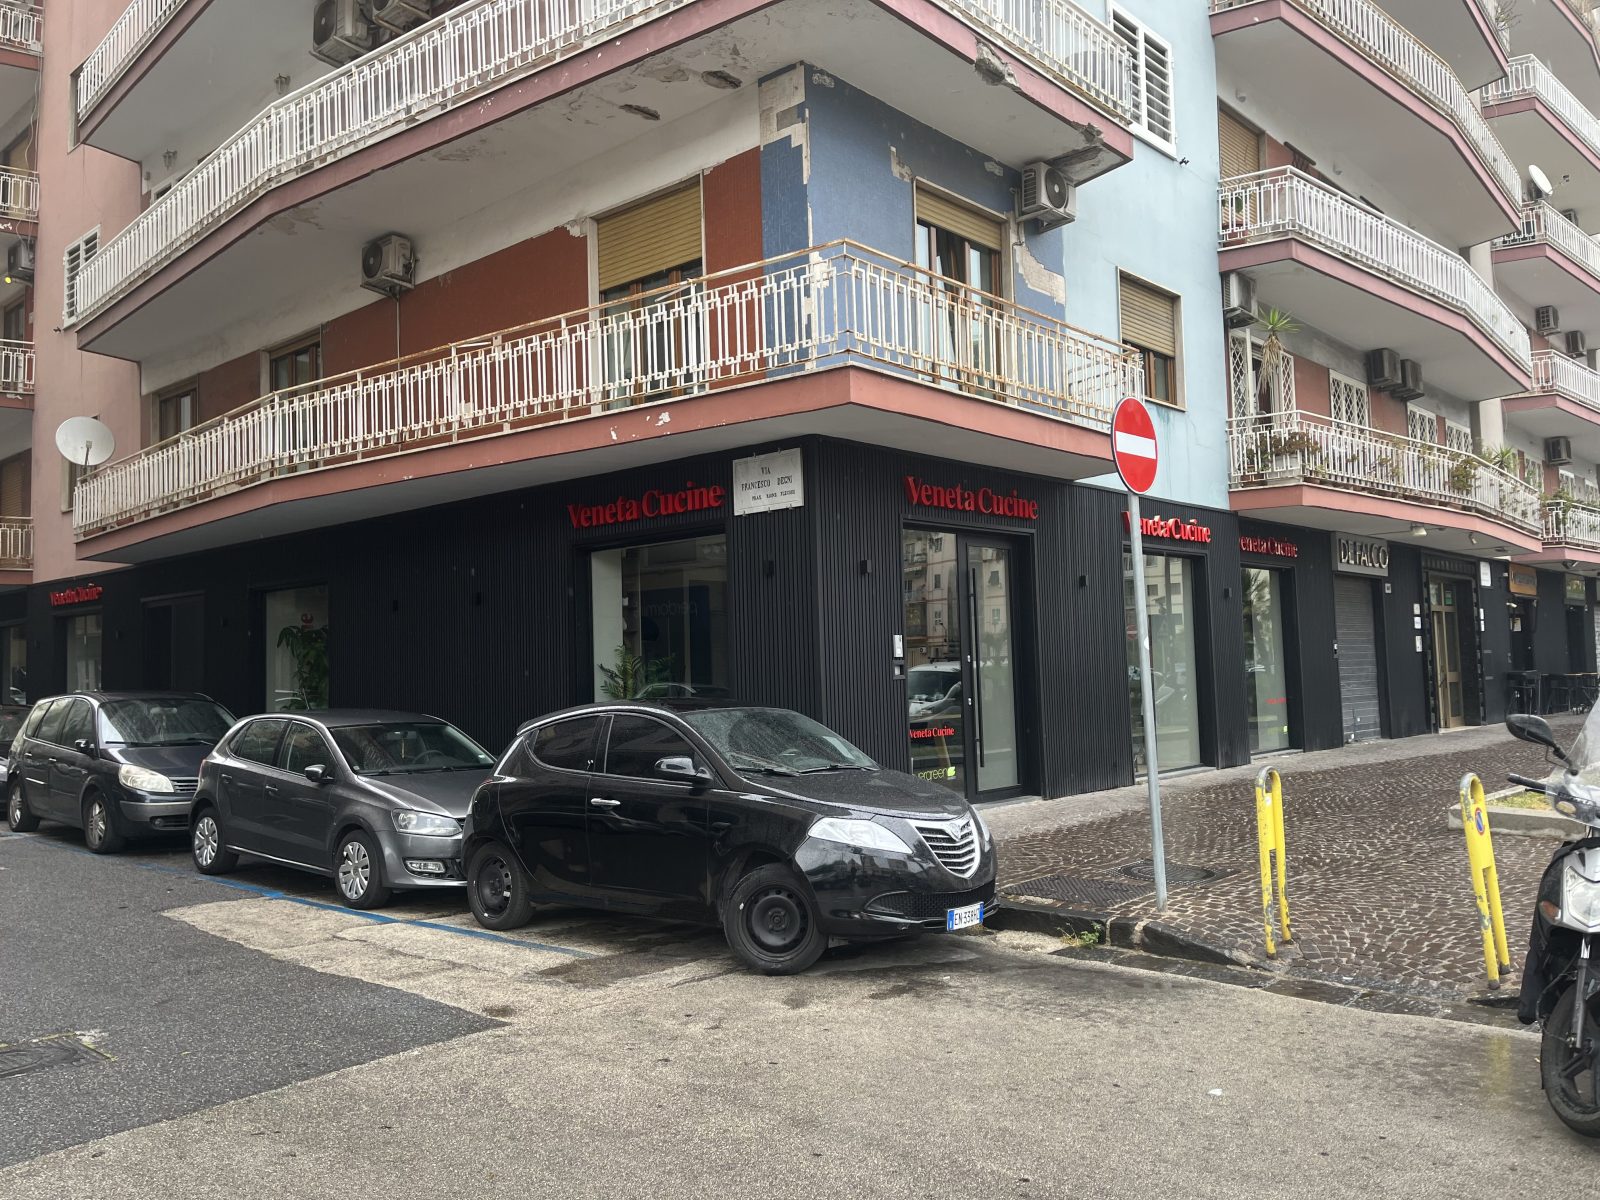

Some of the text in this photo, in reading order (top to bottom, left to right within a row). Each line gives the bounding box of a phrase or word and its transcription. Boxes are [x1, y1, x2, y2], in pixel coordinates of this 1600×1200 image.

[761, 466, 771, 475] VIA
[741, 479, 771, 492] FRANCESCO
[567, 481, 726, 529] Veneta Cucine
[904, 475, 1039, 520] Veneta Cucine
[1170, 518, 1212, 543] Cucine
[1239, 536, 1298, 558] eneta Cucine
[1341, 539, 1389, 569] DE FALCO
[932, 725, 955, 737] Cucine
[913, 768, 947, 783] ergreen
